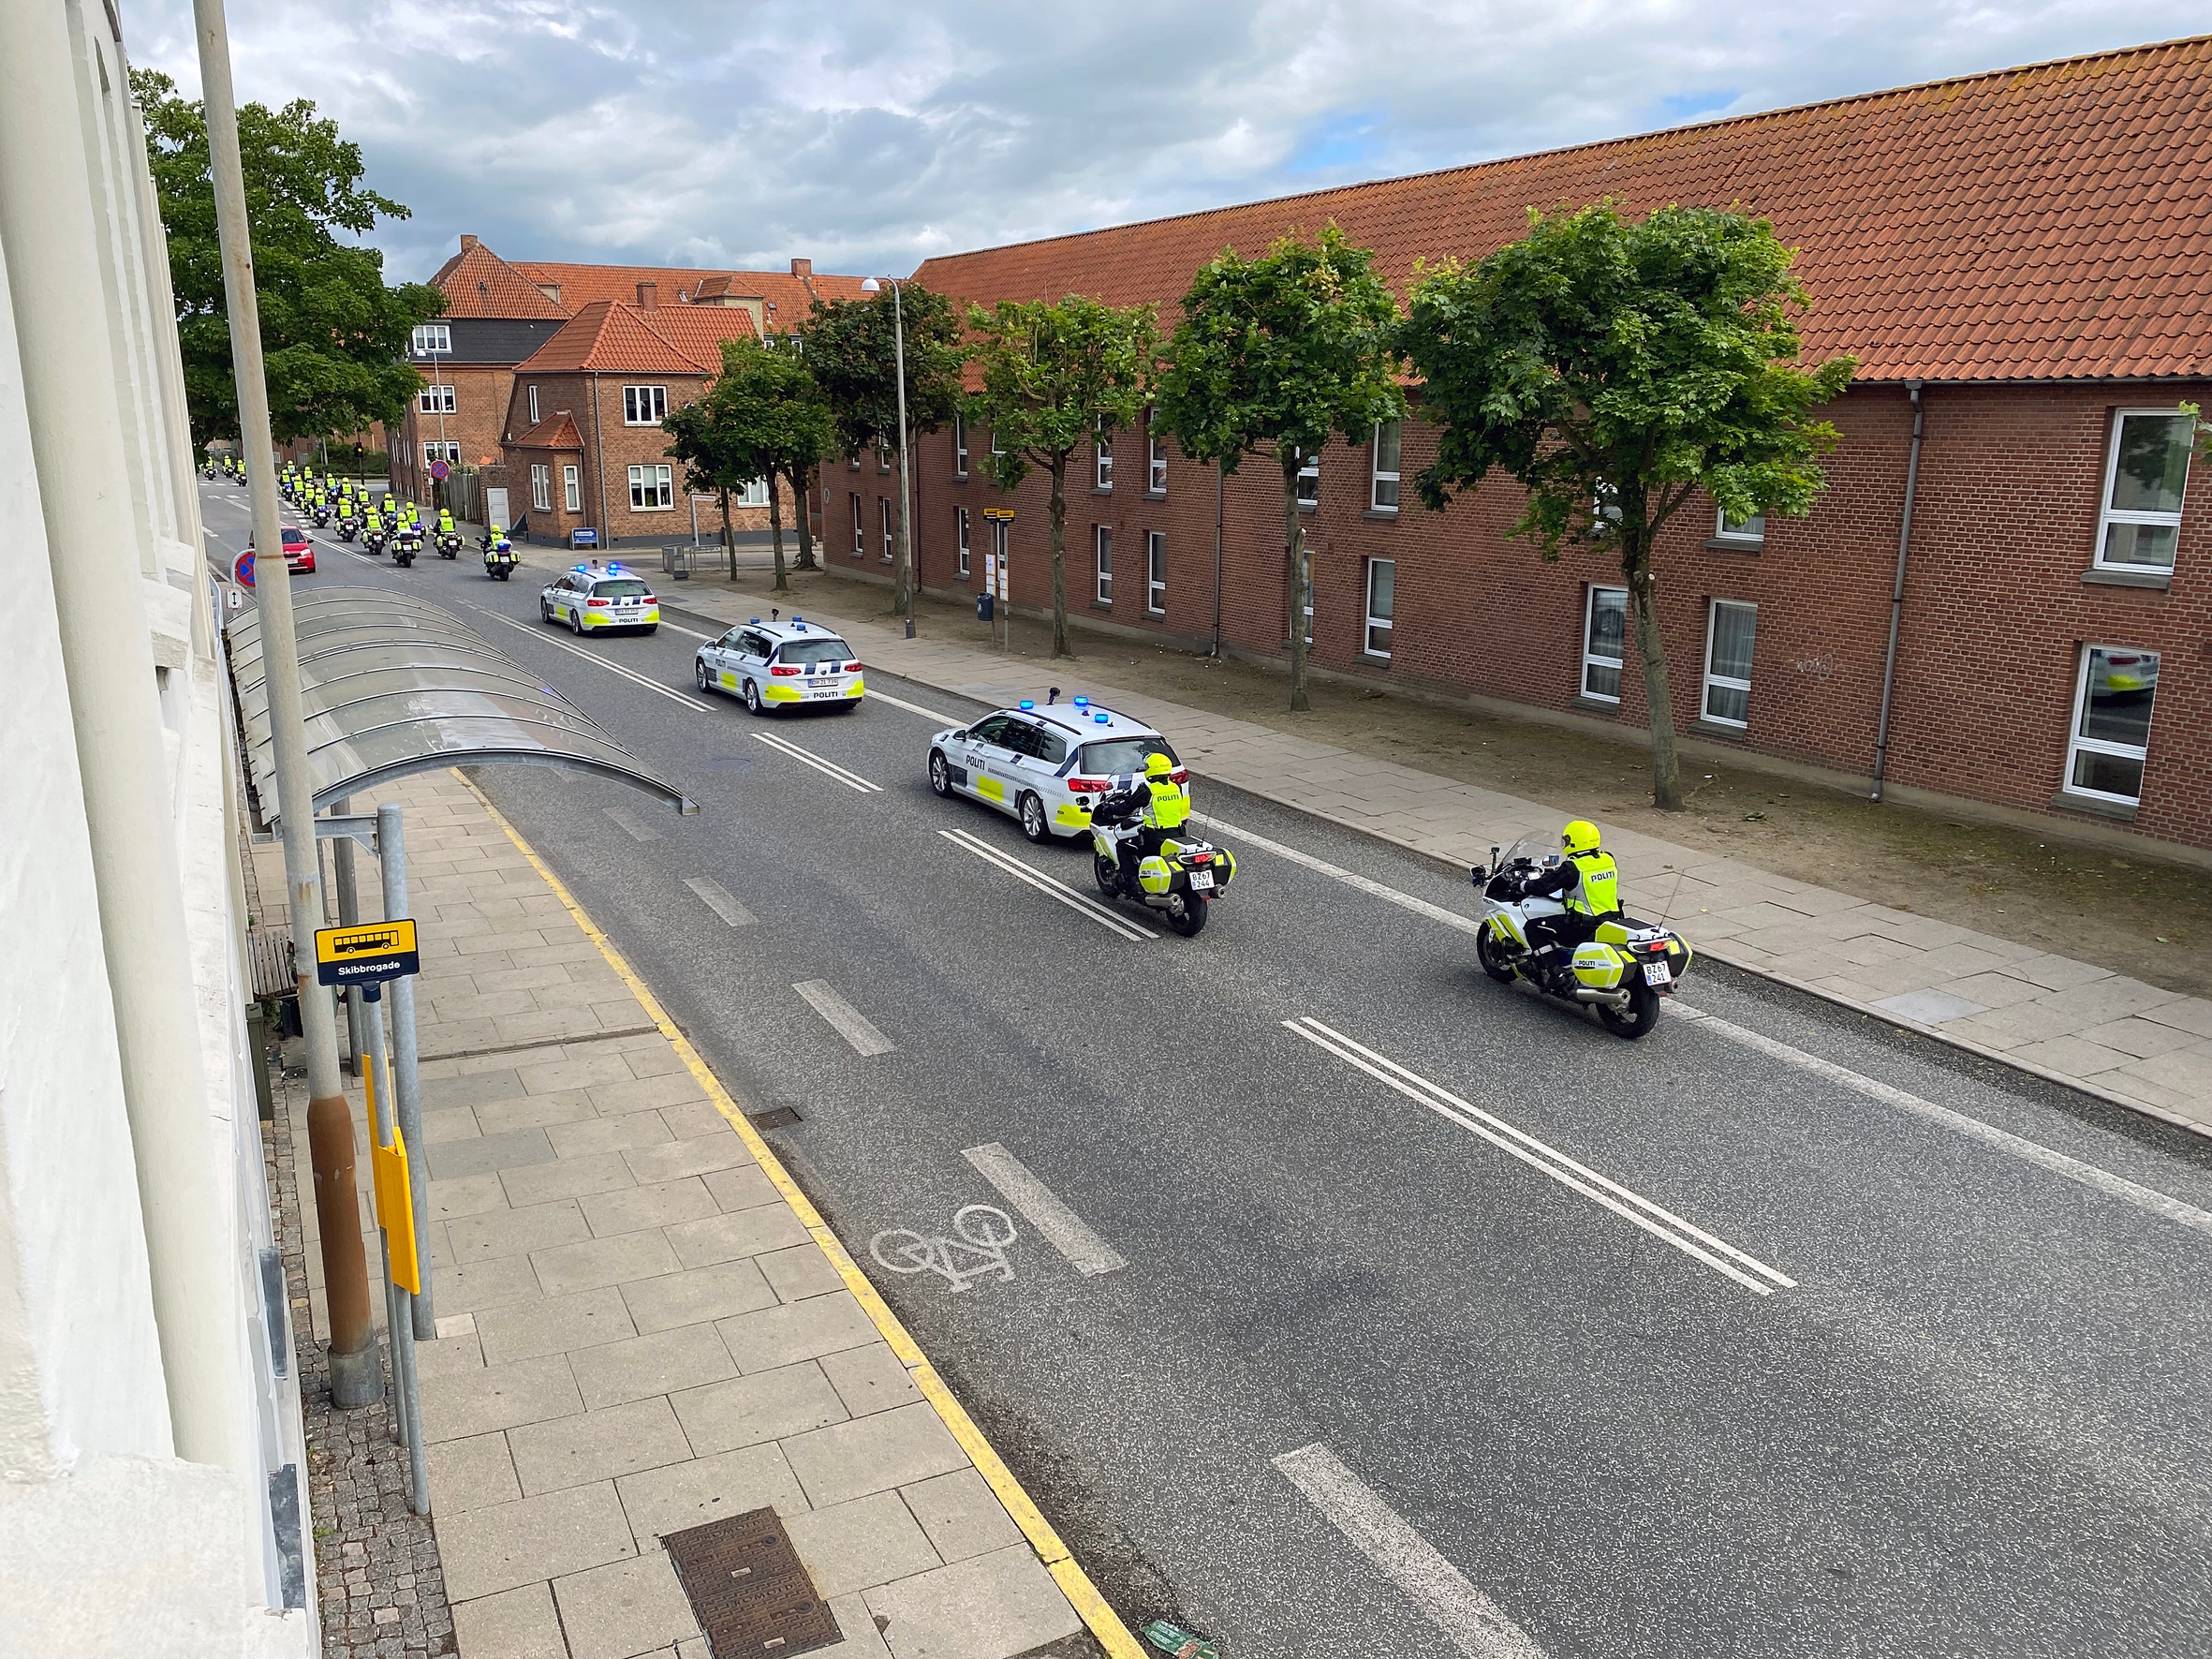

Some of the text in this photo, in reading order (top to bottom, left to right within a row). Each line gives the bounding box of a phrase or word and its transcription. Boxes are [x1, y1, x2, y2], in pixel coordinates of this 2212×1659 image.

[966, 754, 985, 771] POLITI
[1157, 793, 1179, 803] POLITI
[1191, 871, 1211, 881] BZ67
[1590, 870, 1615, 882] POLITI
[1197, 880, 1210, 888] 244
[338, 960, 401, 976] Skibbrogade
[1645, 963, 1667, 975] BZ67
[1651, 972, 1666, 984] 241
